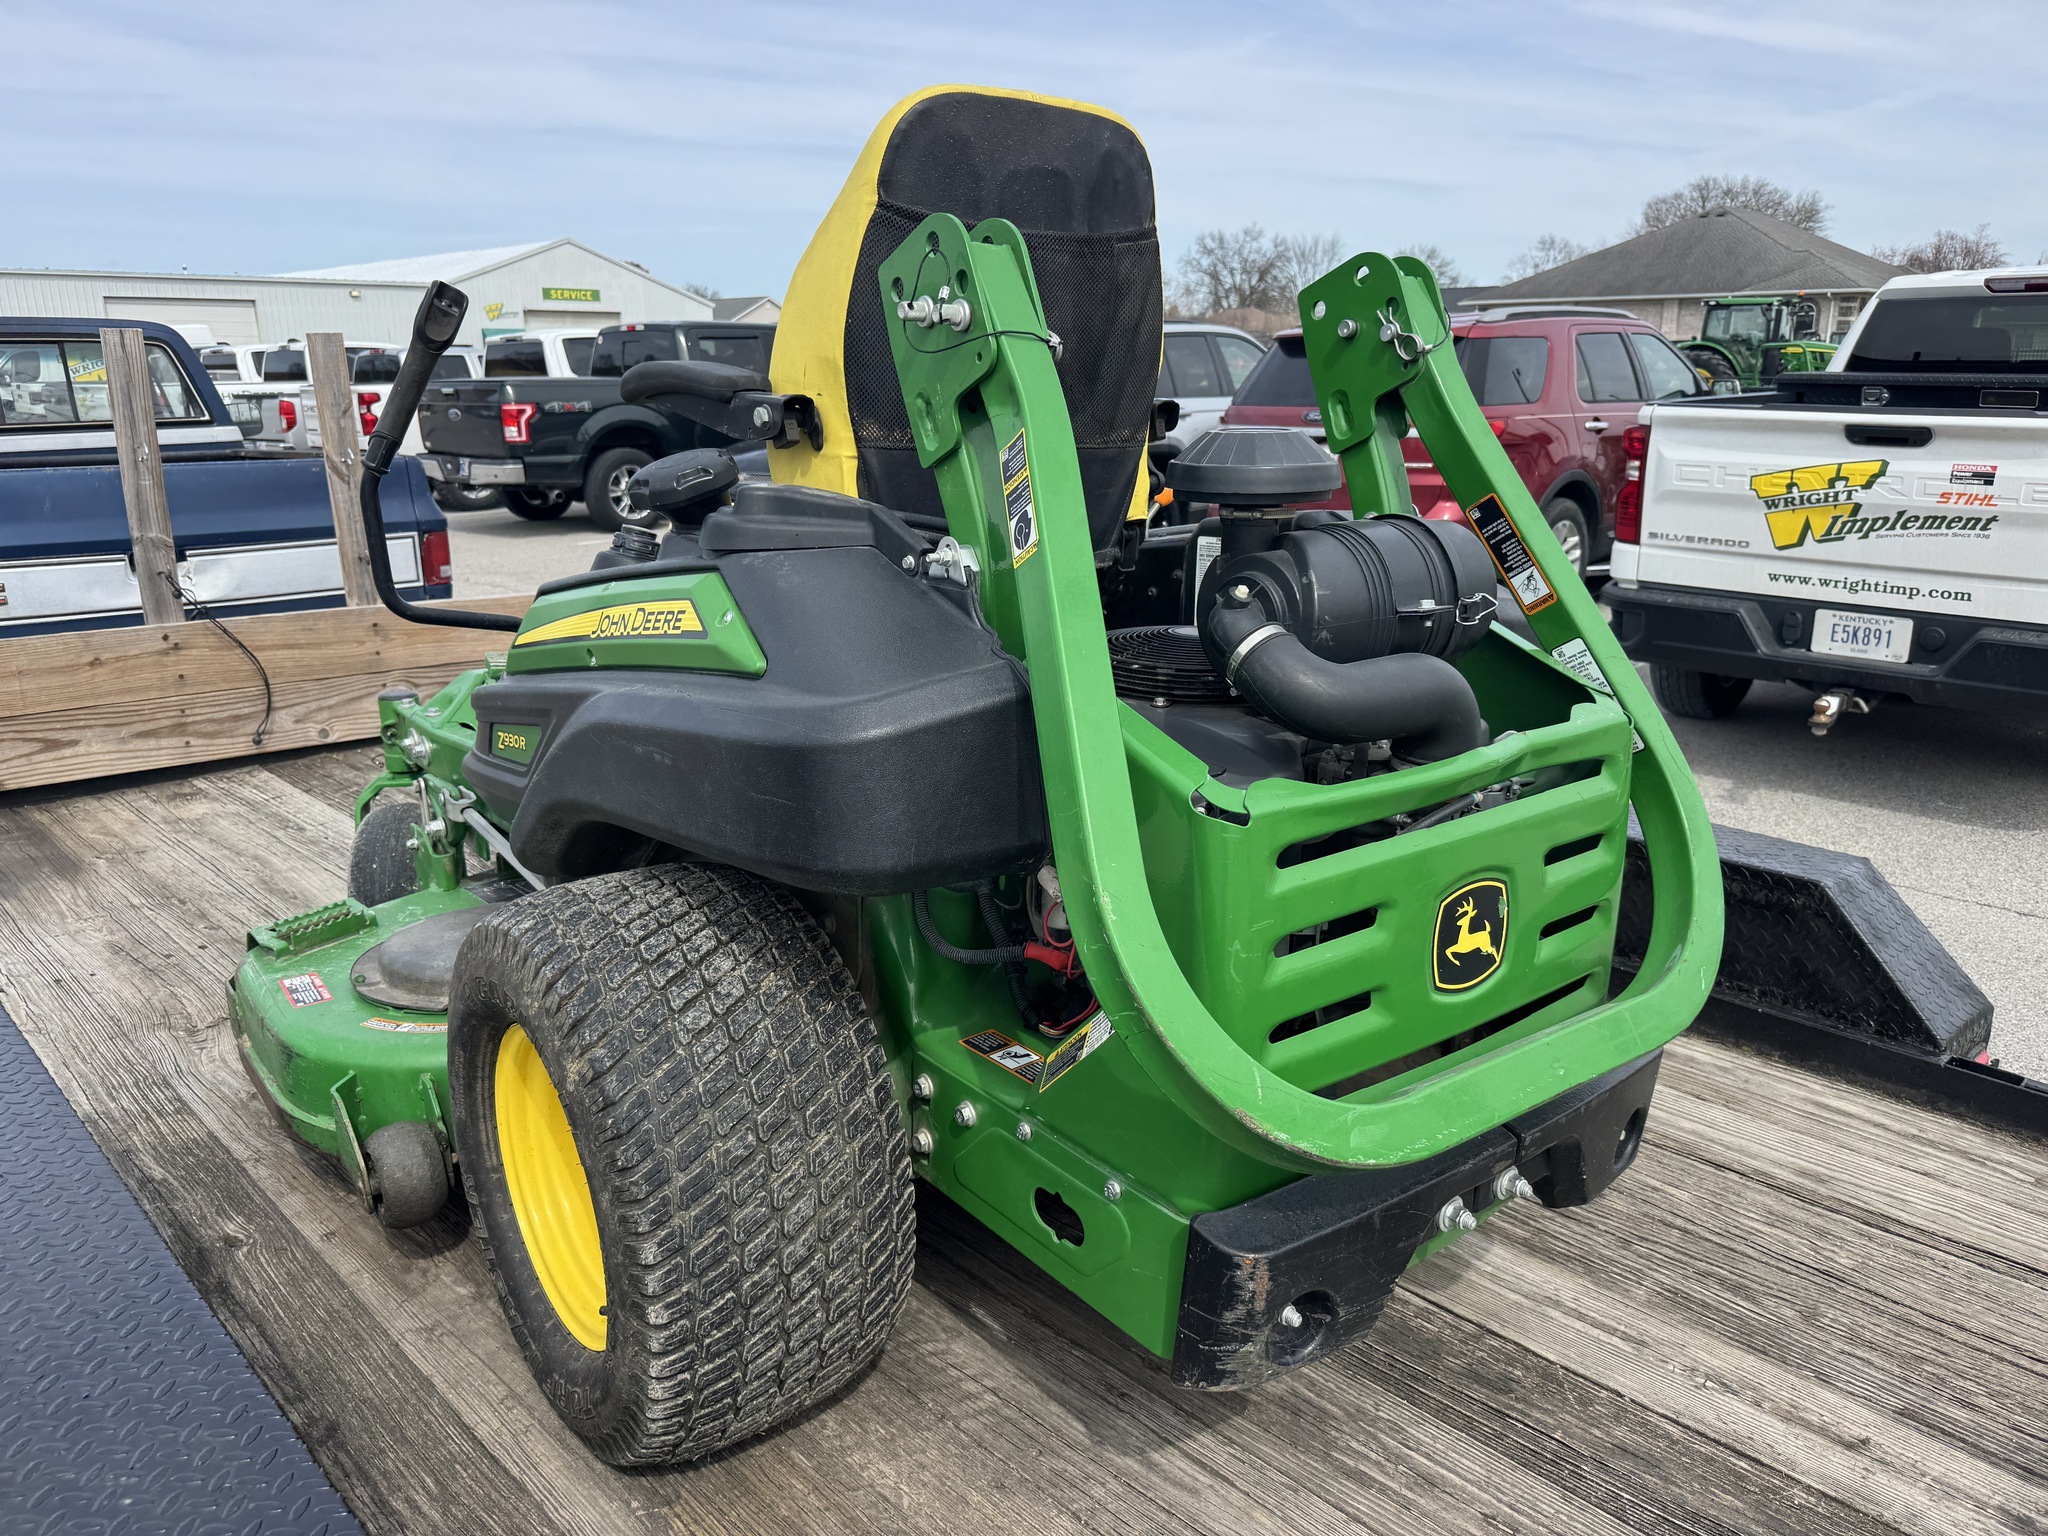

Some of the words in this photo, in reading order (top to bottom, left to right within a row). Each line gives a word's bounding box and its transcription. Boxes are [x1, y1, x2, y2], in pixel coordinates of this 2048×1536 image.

[550, 289, 593, 301] SERVICE
[70, 359, 105, 377] WRIG
[1763, 488, 1859, 511] WRIGHT
[1936, 491, 1998, 507] STIHL
[1819, 510, 2000, 540] Implement
[1647, 531, 1750, 548] SILVERADO
[1767, 572, 1973, 602] www.wrightimp.com
[1525, 597, 1551, 613] WARNING
[591, 611, 633, 637] JOHN
[632, 607, 687, 635] DEERE
[1838, 614, 1889, 626] KENTUCKY
[1830, 623, 1893, 649] E5K891
[497, 731, 526, 750] Z930R
